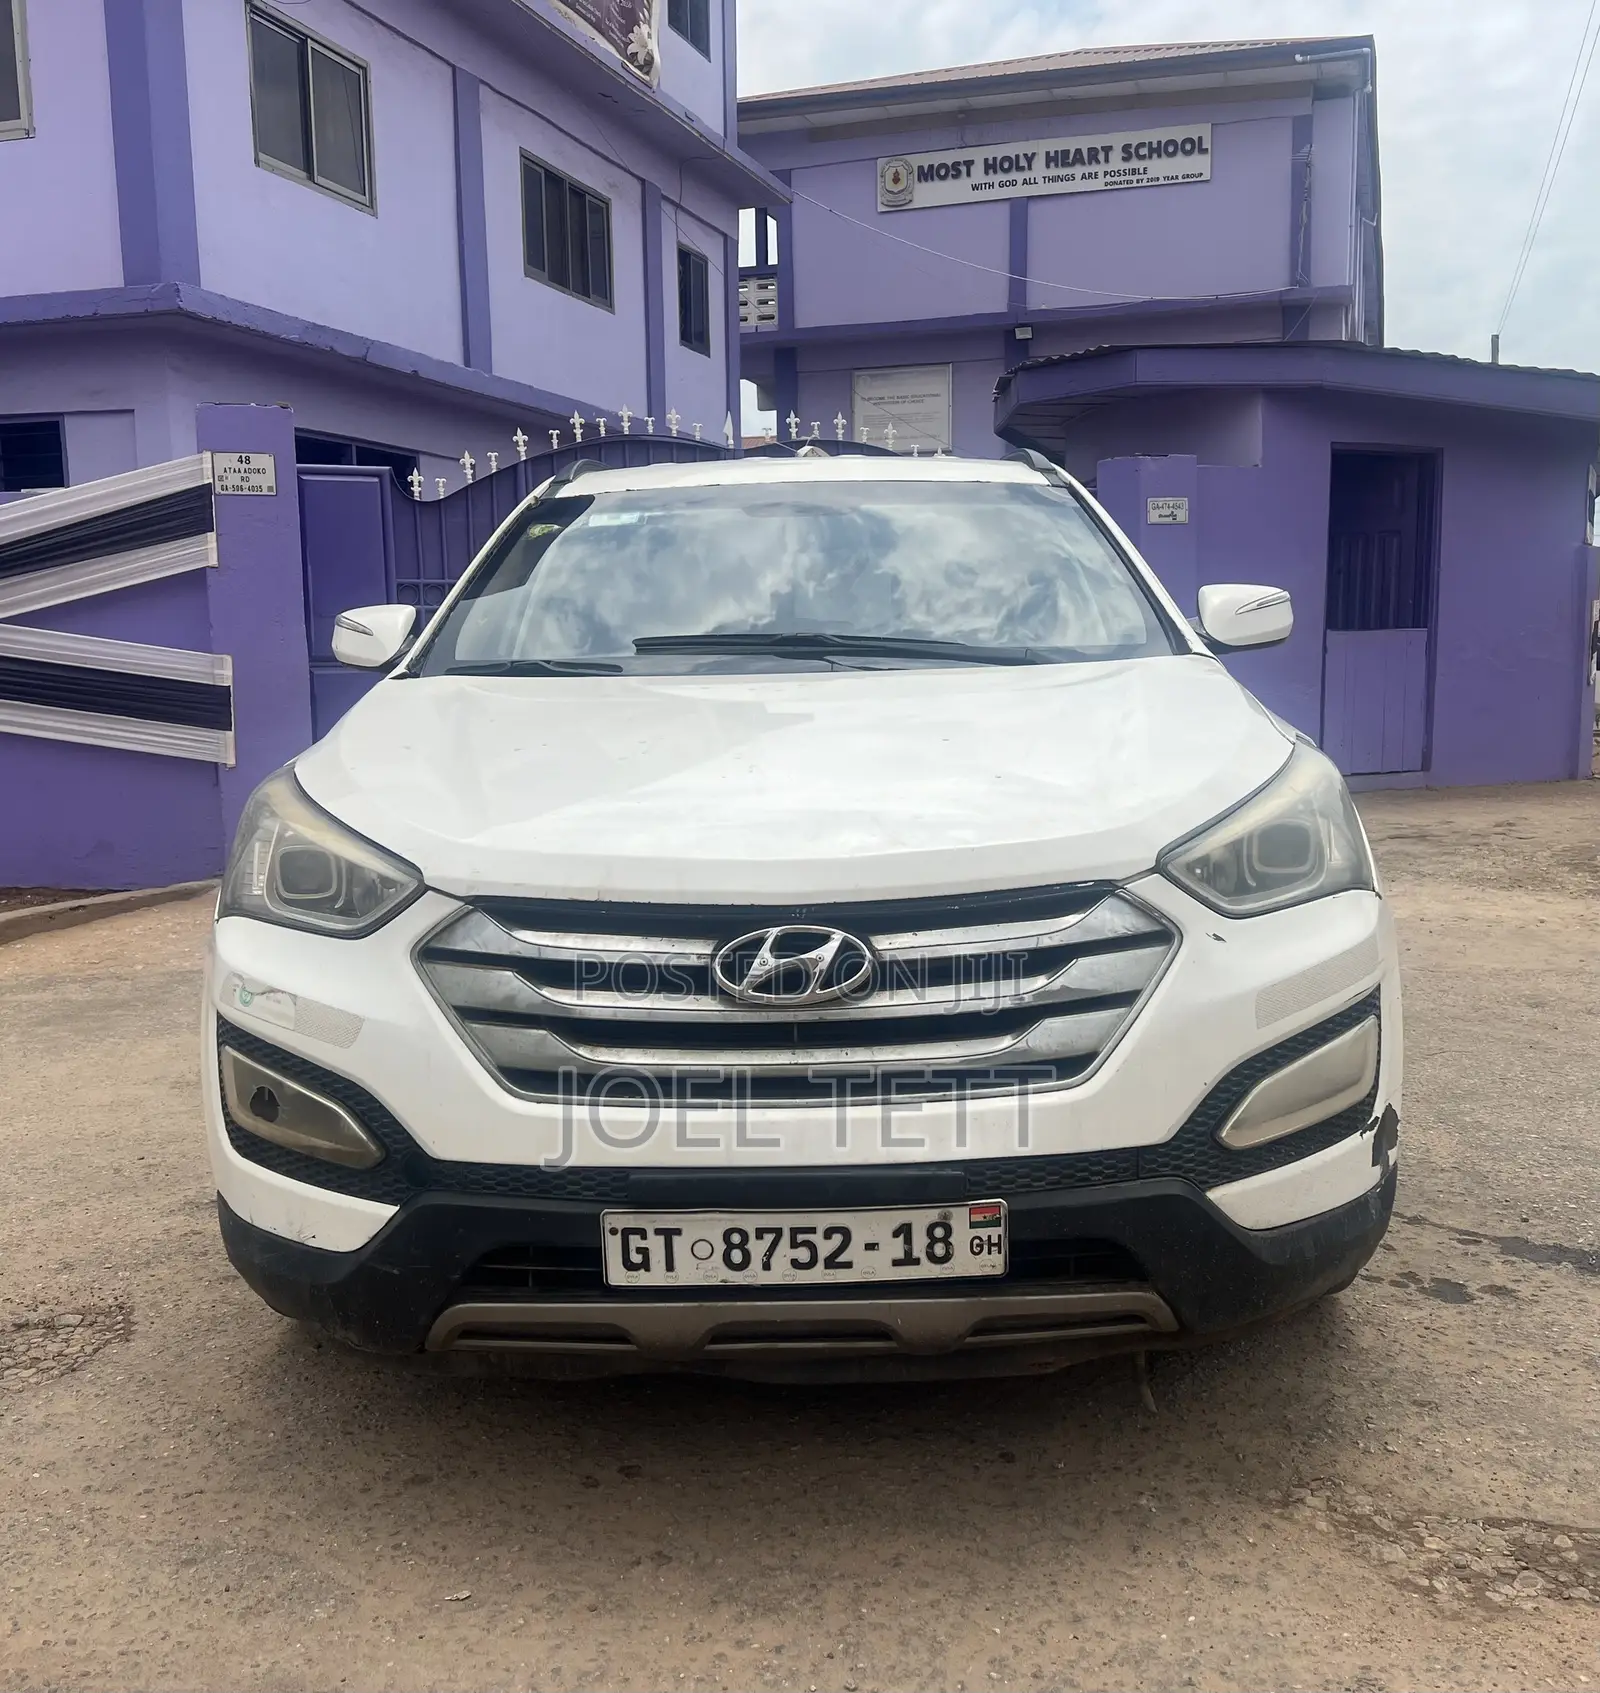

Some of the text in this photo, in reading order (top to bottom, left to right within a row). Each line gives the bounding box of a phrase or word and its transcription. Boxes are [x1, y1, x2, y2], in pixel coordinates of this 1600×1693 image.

[917, 159, 975, 183] MOST
[983, 152, 1037, 175] HOLY
[1044, 145, 1114, 169] HEART
[1121, 135, 1209, 163] SCHOOL
[971, 166, 1149, 192] WITH GOD ALL THINGS ARE POSSIBLE
[1104, 179, 1134, 188] DONATED
[1163, 174, 1179, 182] YEAR
[1181, 172, 1204, 181] GROUP
[237, 455, 251, 465] 48
[621, 1226, 683, 1273] GT
[968, 1233, 1002, 1257] GH
